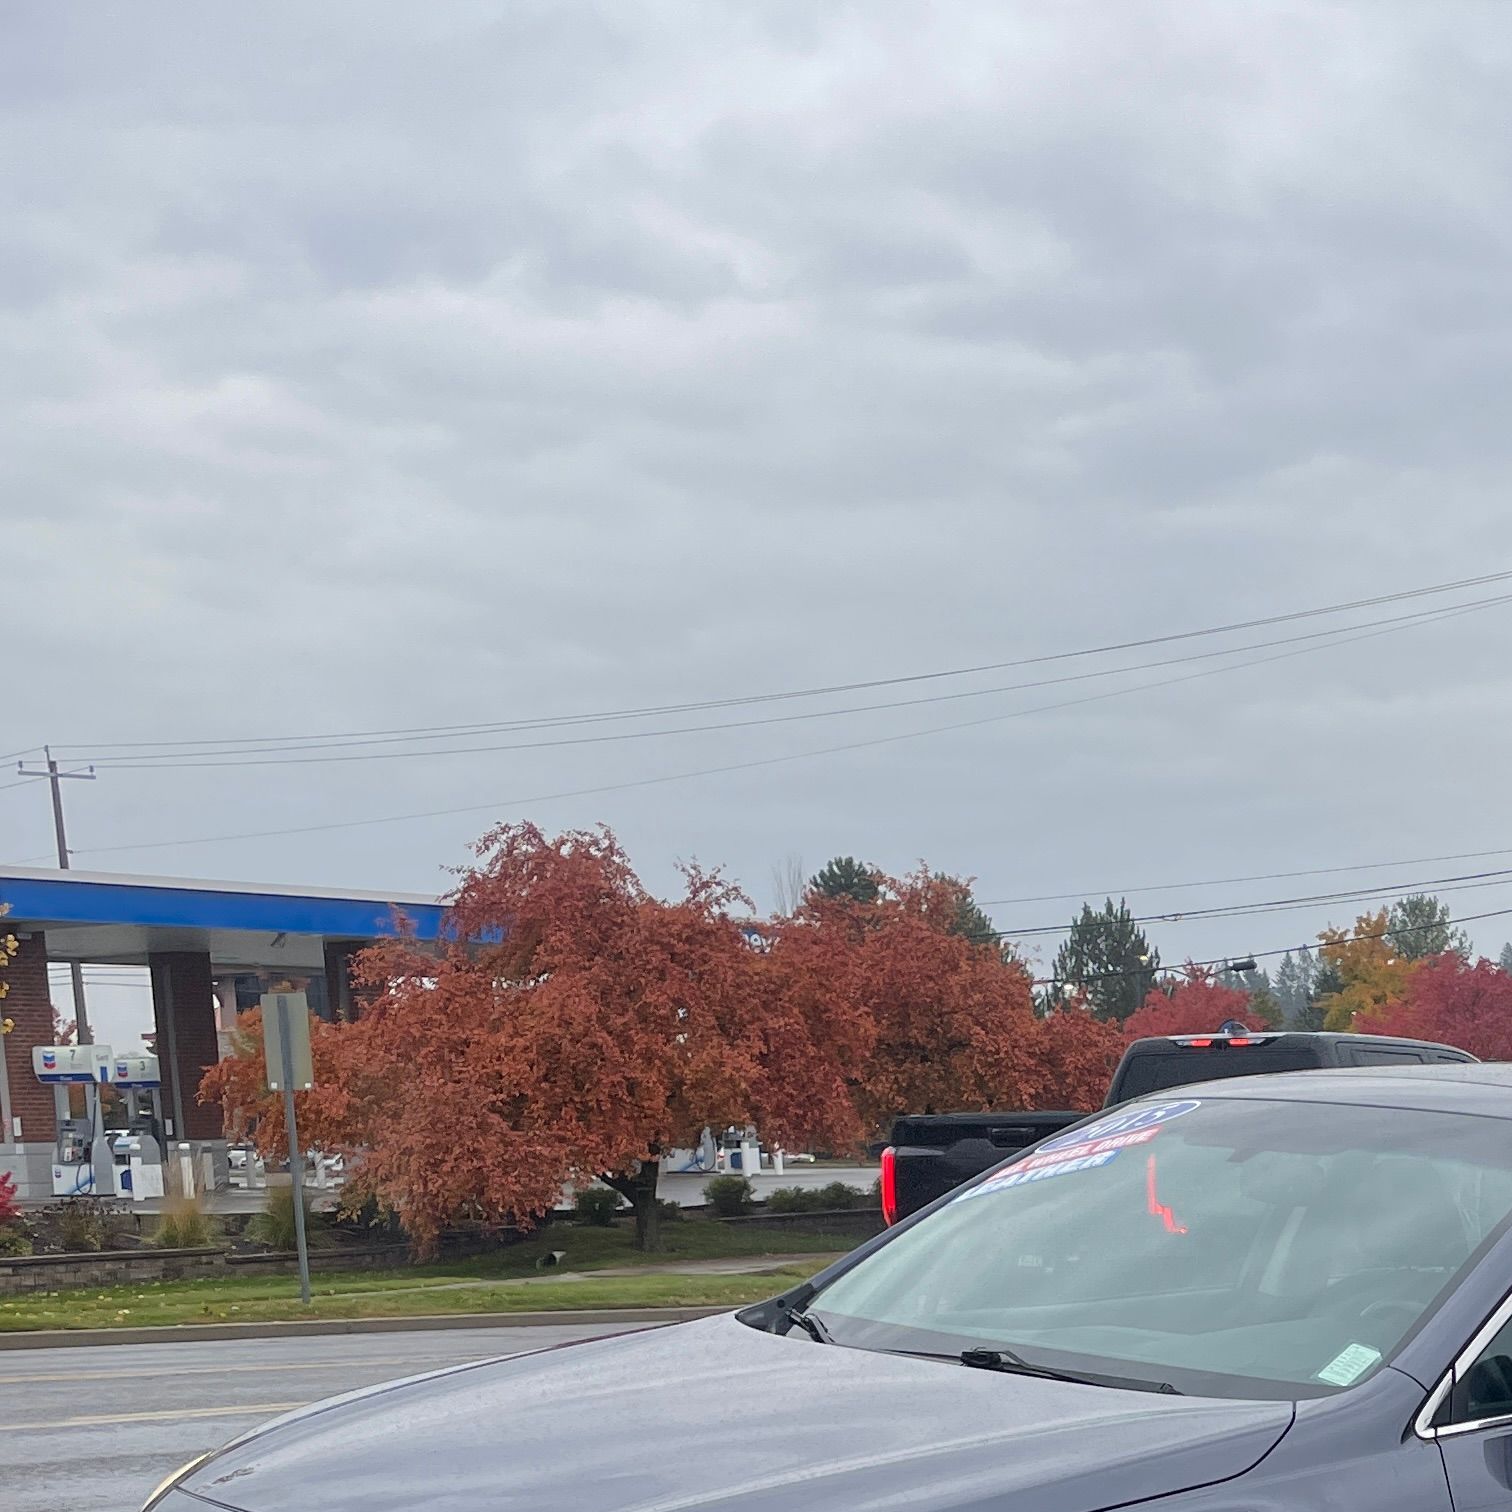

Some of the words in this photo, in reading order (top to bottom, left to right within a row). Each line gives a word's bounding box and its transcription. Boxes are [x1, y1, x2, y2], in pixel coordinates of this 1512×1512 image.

[69, 1049, 76, 1061] 7
[140, 1060, 146, 1071] 3
[1026, 1144, 1093, 1170] WHEEL
[1091, 1128, 1157, 1153] DRIVE
